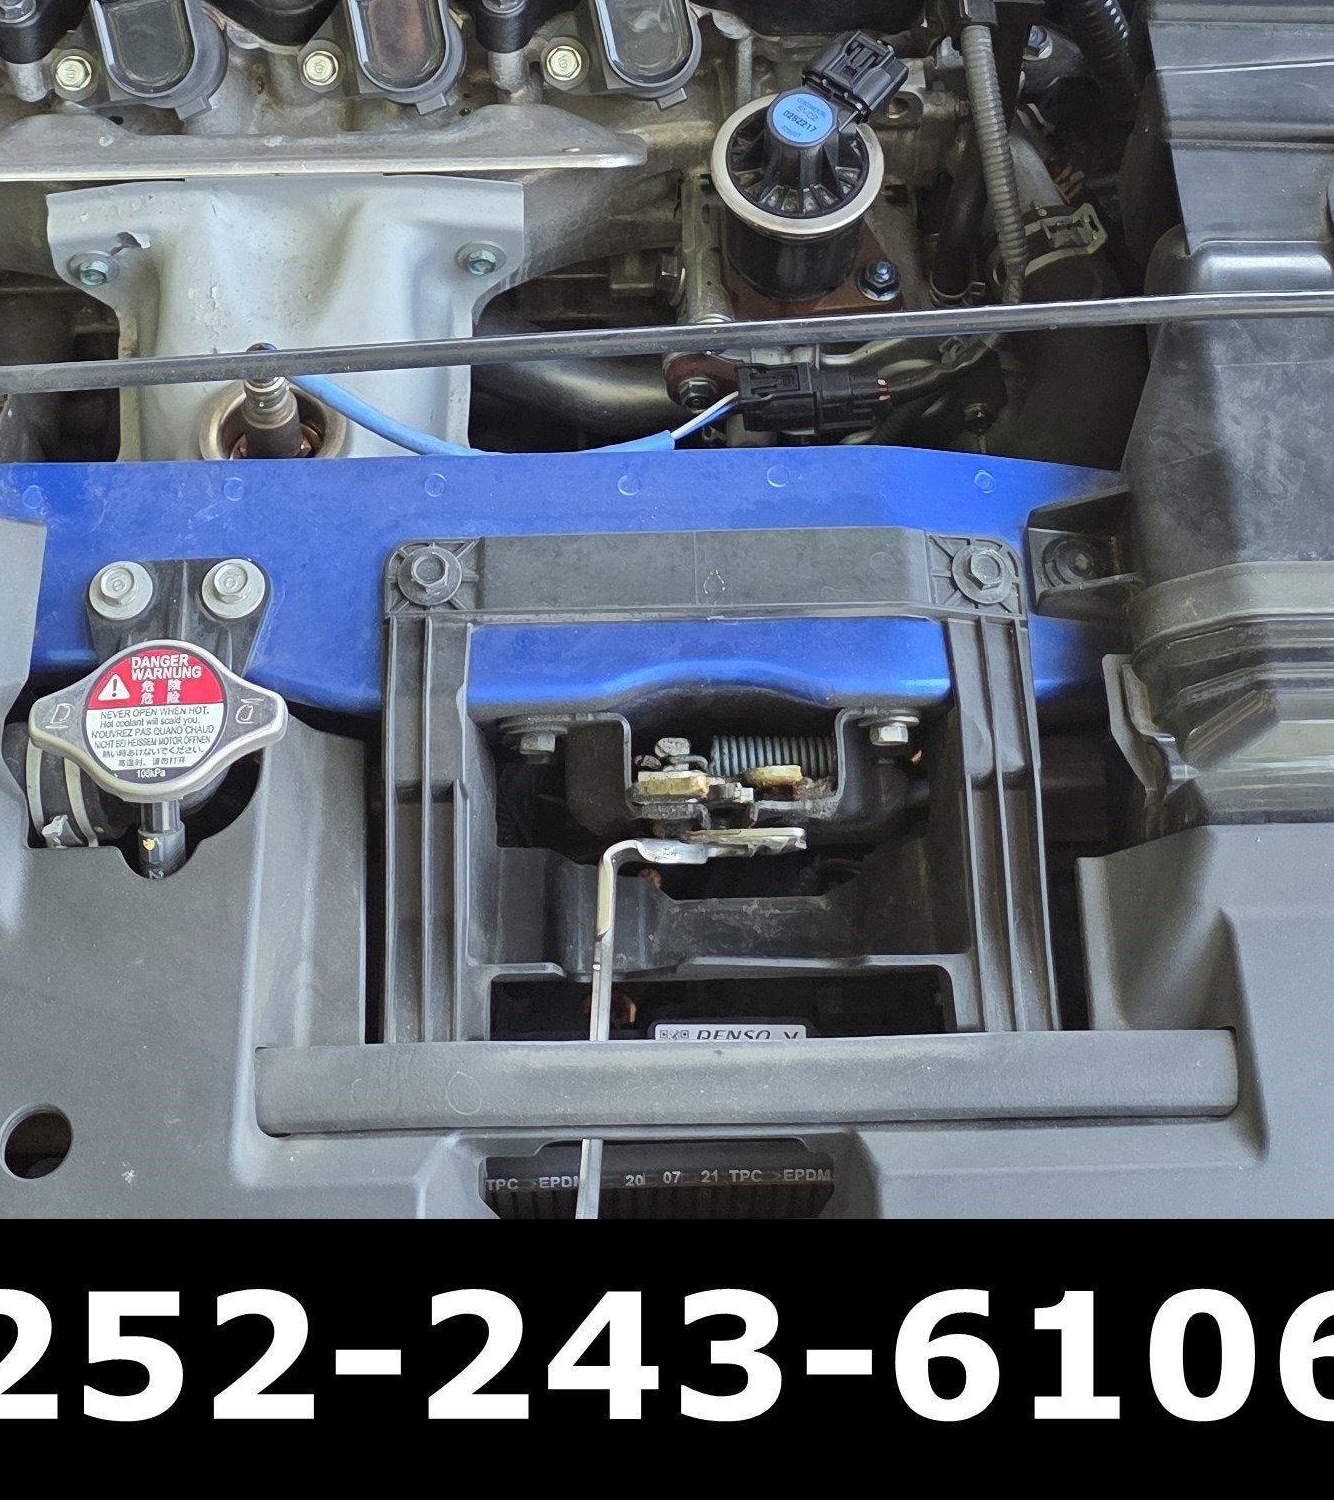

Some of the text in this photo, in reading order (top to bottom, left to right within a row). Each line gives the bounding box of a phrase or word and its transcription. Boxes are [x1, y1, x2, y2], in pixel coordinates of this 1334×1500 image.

[131, 654, 189, 669] DANGER
[131, 665, 202, 680] WARNUNG
[100, 706, 210, 719] NEVER OPEN WHEN HOT.
[115, 719, 145, 727] coolant
[160, 717, 181, 725] scald
[91, 729, 133, 739] N'OUVREZ
[134, 728, 152, 736] PAS
[153, 726, 183, 736] QUAND
[94, 740, 114, 749] NICHT
[115, 739, 126, 747] BEI
[158, 737, 182, 746] MOTOR
[485, 1178, 519, 1191] TPC
[662, 1171, 682, 1184] 07
[729, 1168, 763, 1183] TPC
